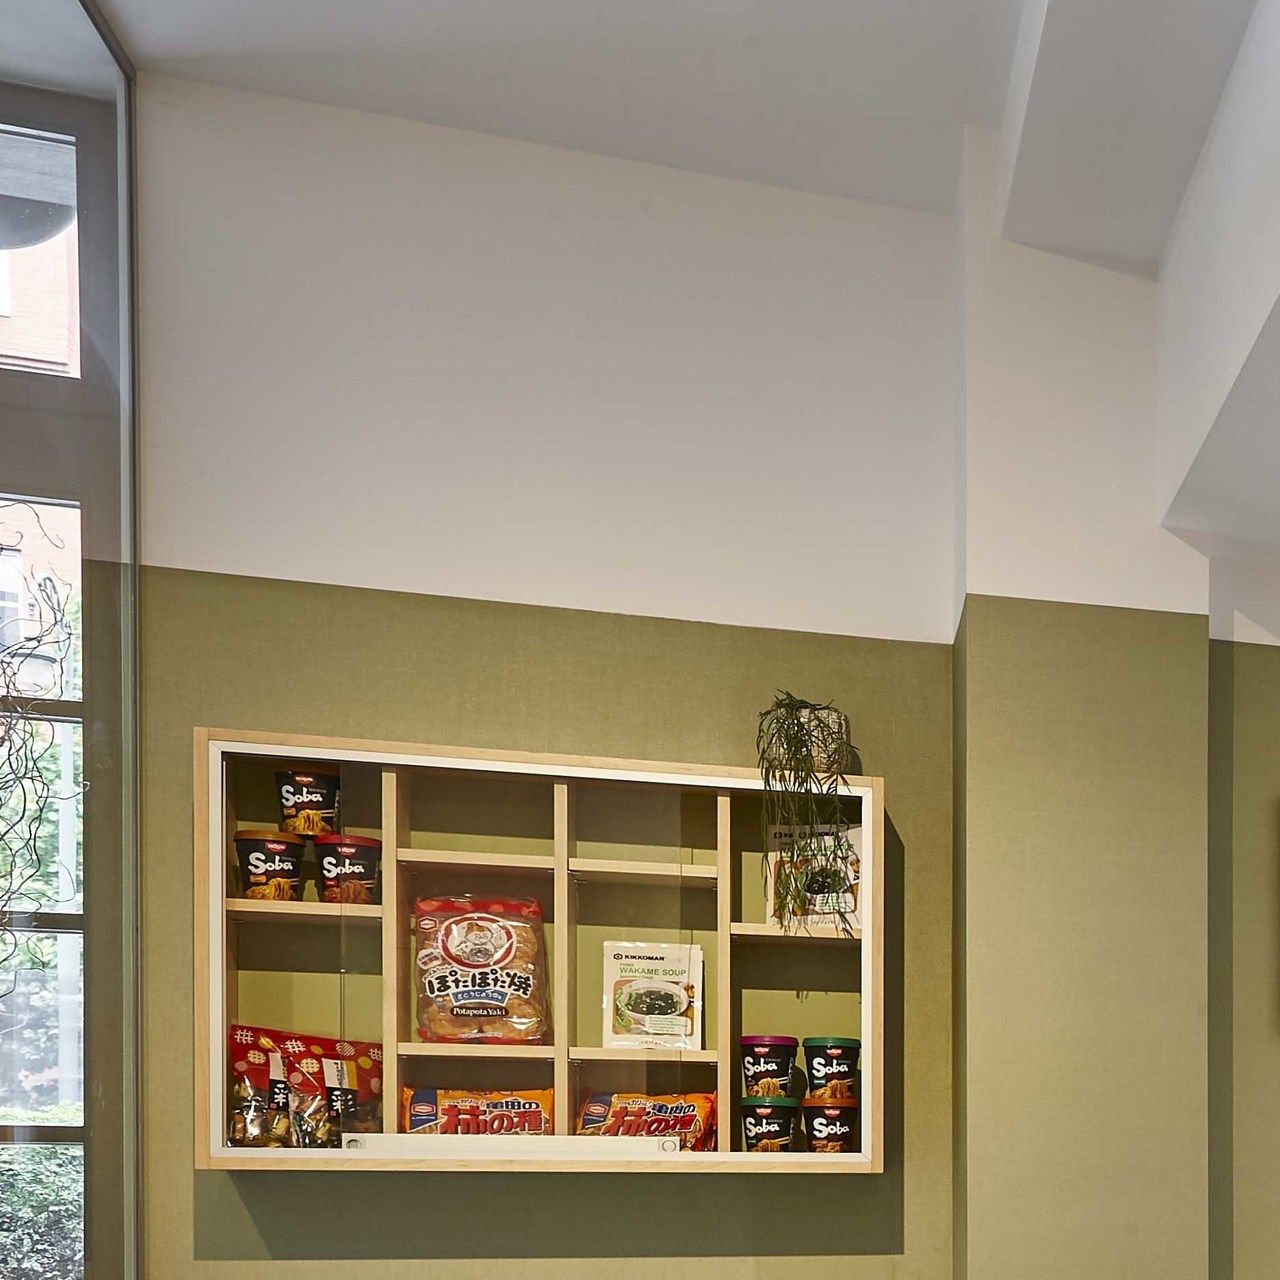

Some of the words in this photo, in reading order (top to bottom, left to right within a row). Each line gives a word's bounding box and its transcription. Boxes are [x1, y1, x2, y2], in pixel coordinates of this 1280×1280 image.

[281, 784, 323, 807] Soba
[247, 852, 293, 875] Soba
[323, 856, 365, 879] Soba
[427, 968, 533, 997] ぽたぽた焼
[619, 966, 660, 976] WAKAME
[662, 968, 687, 977] SOUP
[744, 1056, 778, 1076] Soba
[811, 1057, 849, 1078] Soba
[439, 1104, 543, 1135] 柿の種
[745, 1117, 780, 1137] Soba
[812, 1117, 850, 1139] Soba
